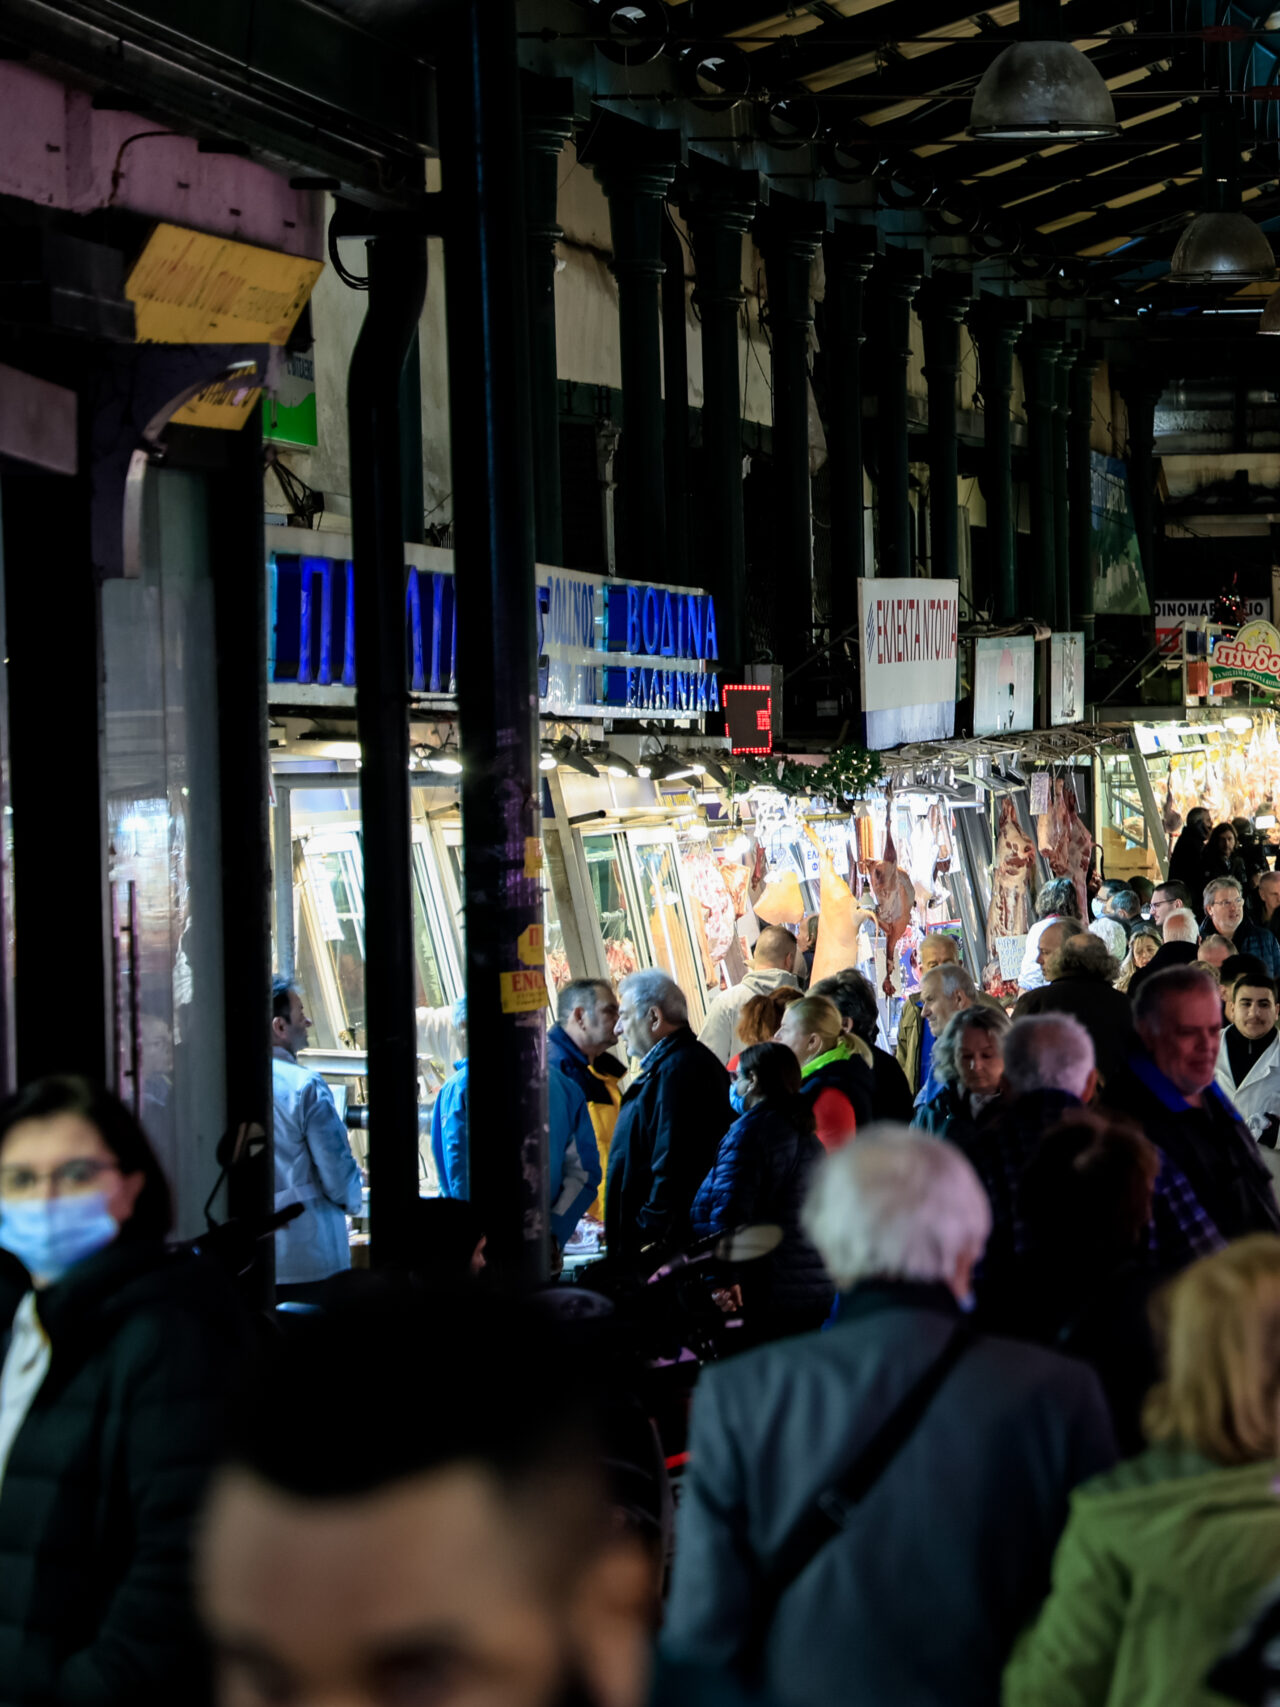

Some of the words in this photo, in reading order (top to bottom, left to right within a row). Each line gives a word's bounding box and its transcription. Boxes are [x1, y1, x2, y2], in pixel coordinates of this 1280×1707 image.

[626, 584, 719, 660] ΒΟΔΙΝΑ
[877, 599, 921, 664] ΕΚΛΕΚΤΑ
[626, 666, 720, 712] ΕΛΛΗΝΙΚΑ
